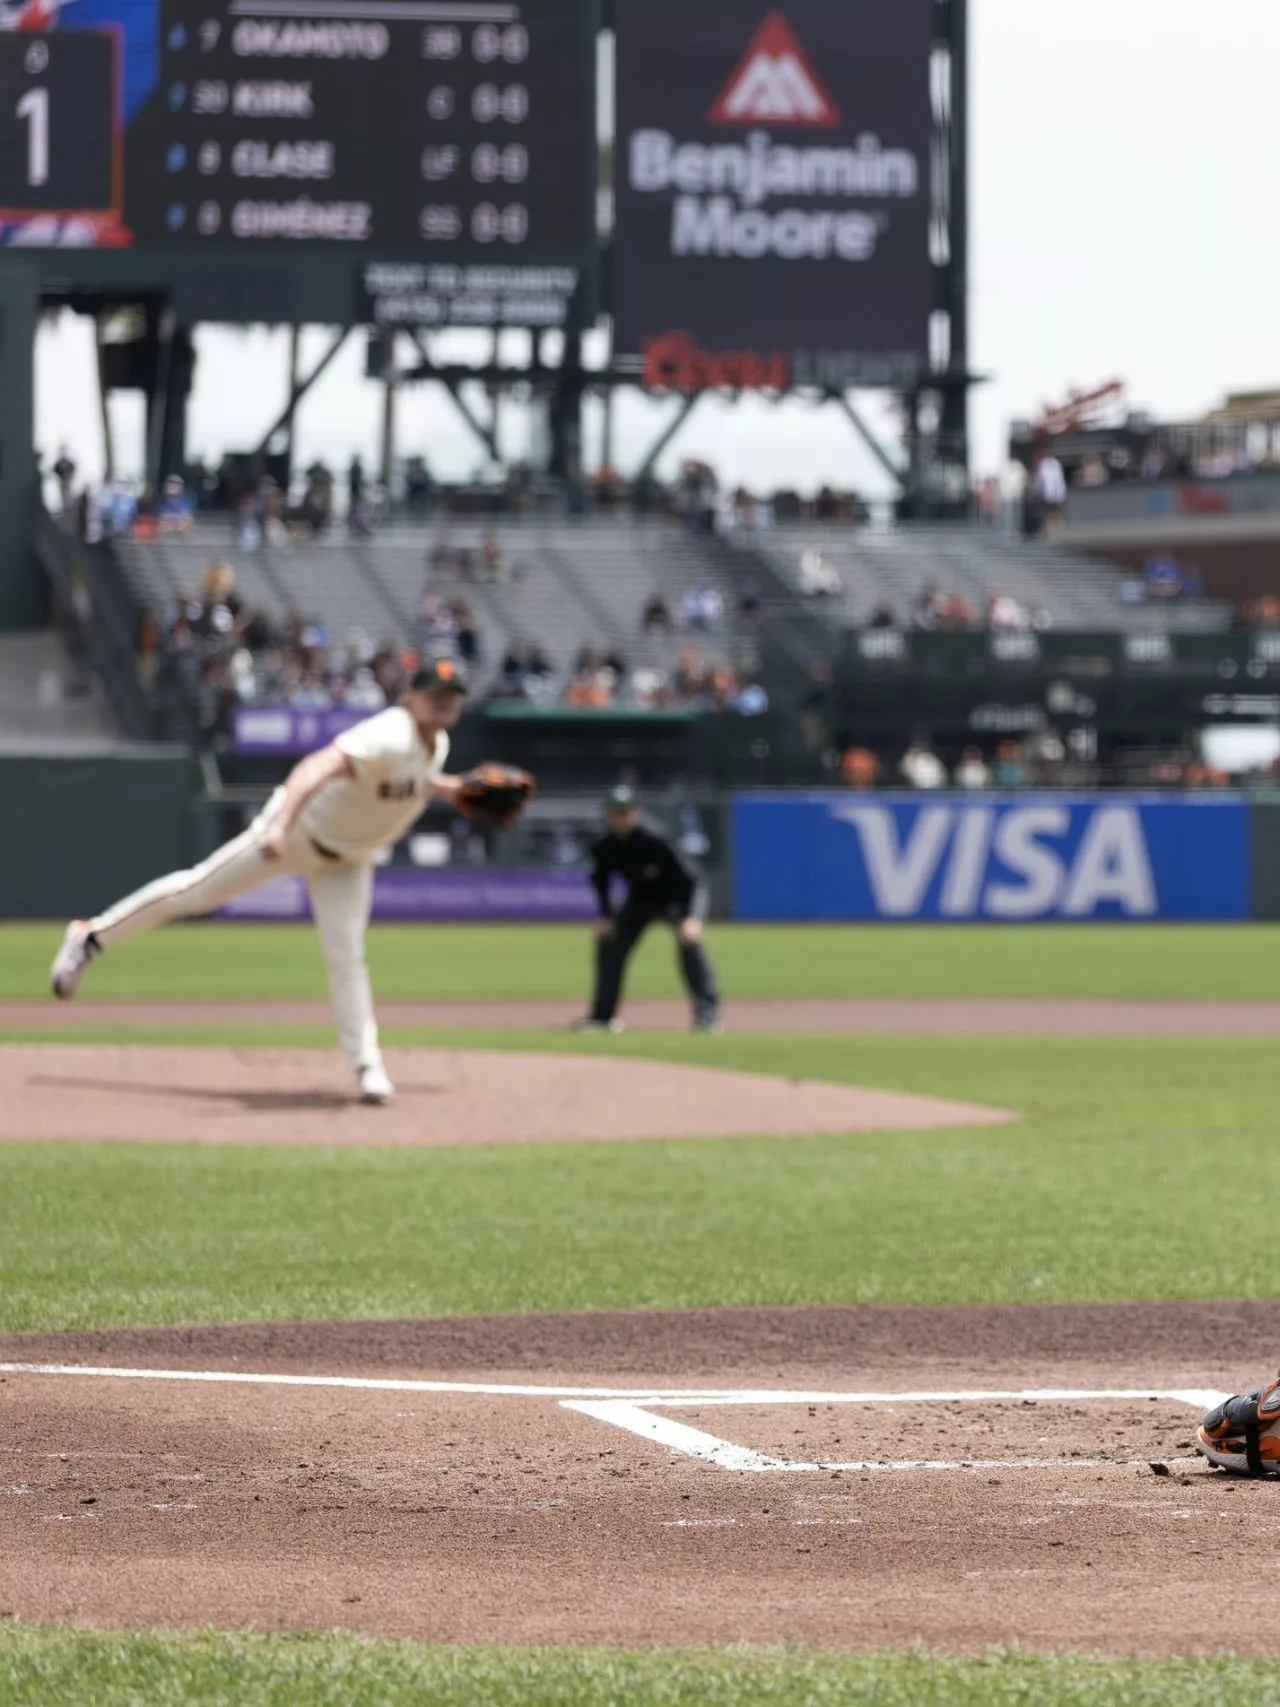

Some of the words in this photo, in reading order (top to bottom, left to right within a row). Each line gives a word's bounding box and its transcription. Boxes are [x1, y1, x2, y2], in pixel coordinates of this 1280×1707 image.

[231, 21, 389, 59] OKAMOTO
[232, 81, 313, 117] KIRK
[16, 86, 49, 186] 1
[231, 141, 334, 178] CLASE
[629, 129, 917, 207] Benjamin
[671, 196, 876, 261] Moore
[828, 804, 1158, 917] VISA
